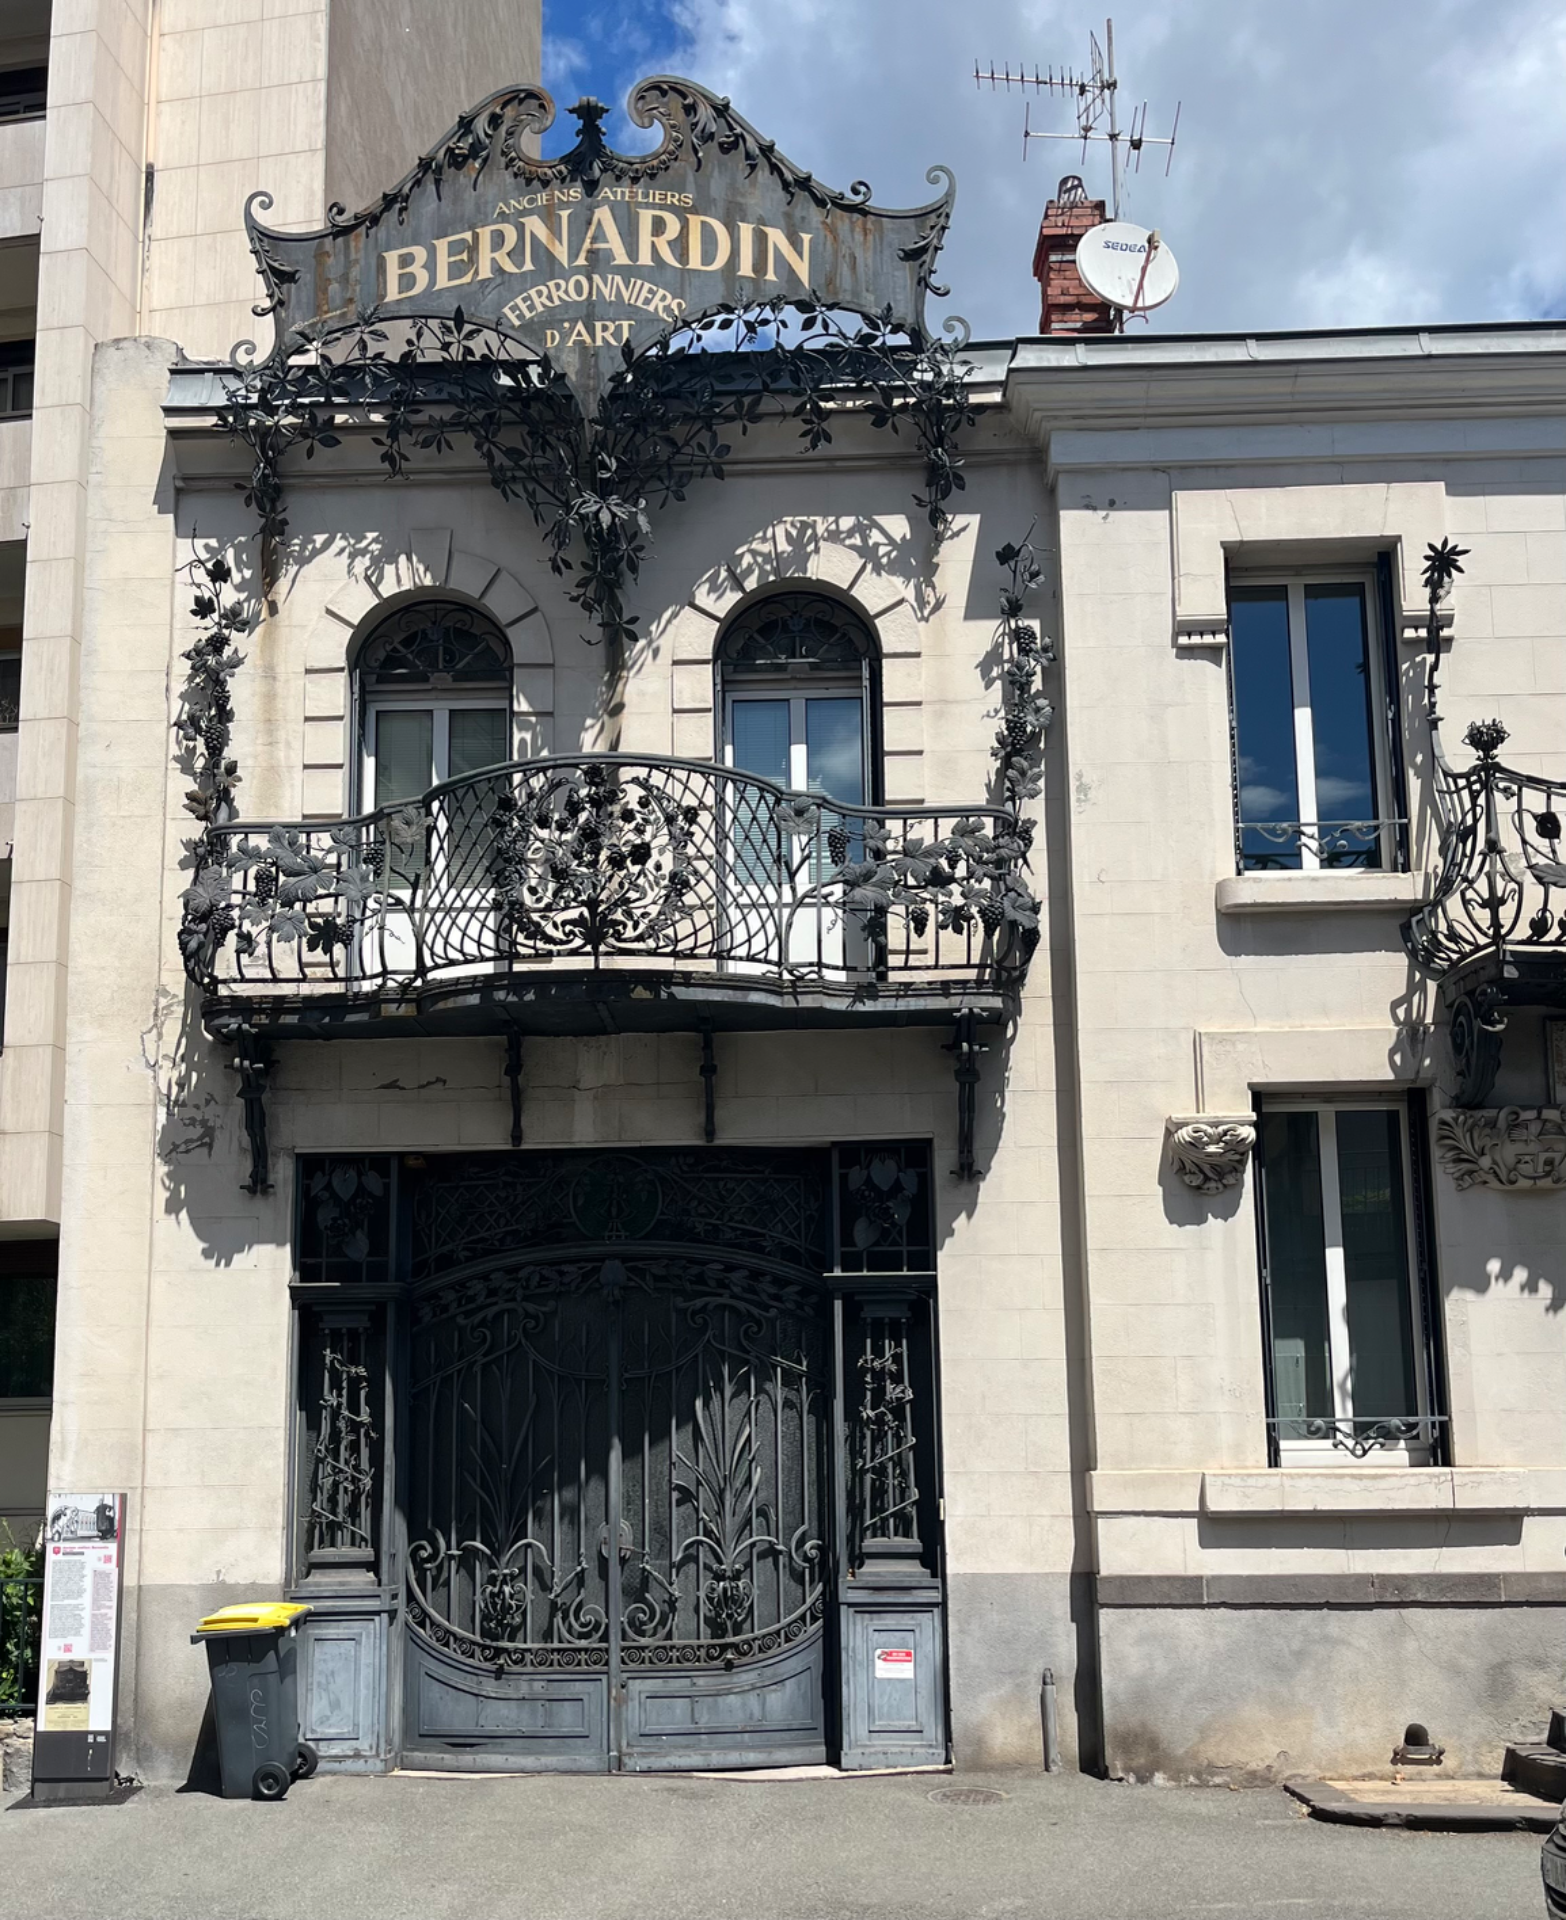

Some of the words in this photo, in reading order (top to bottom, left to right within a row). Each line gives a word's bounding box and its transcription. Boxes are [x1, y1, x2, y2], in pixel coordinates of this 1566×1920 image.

[493, 188, 582, 218] ANCIENS
[597, 187, 694, 207] ATELIERS
[381, 204, 813, 303] BERNARDIN
[1103, 240, 1147, 253] SEDEA
[502, 274, 687, 328] FERRONNIERS
[545, 319, 636, 348] D'ART
